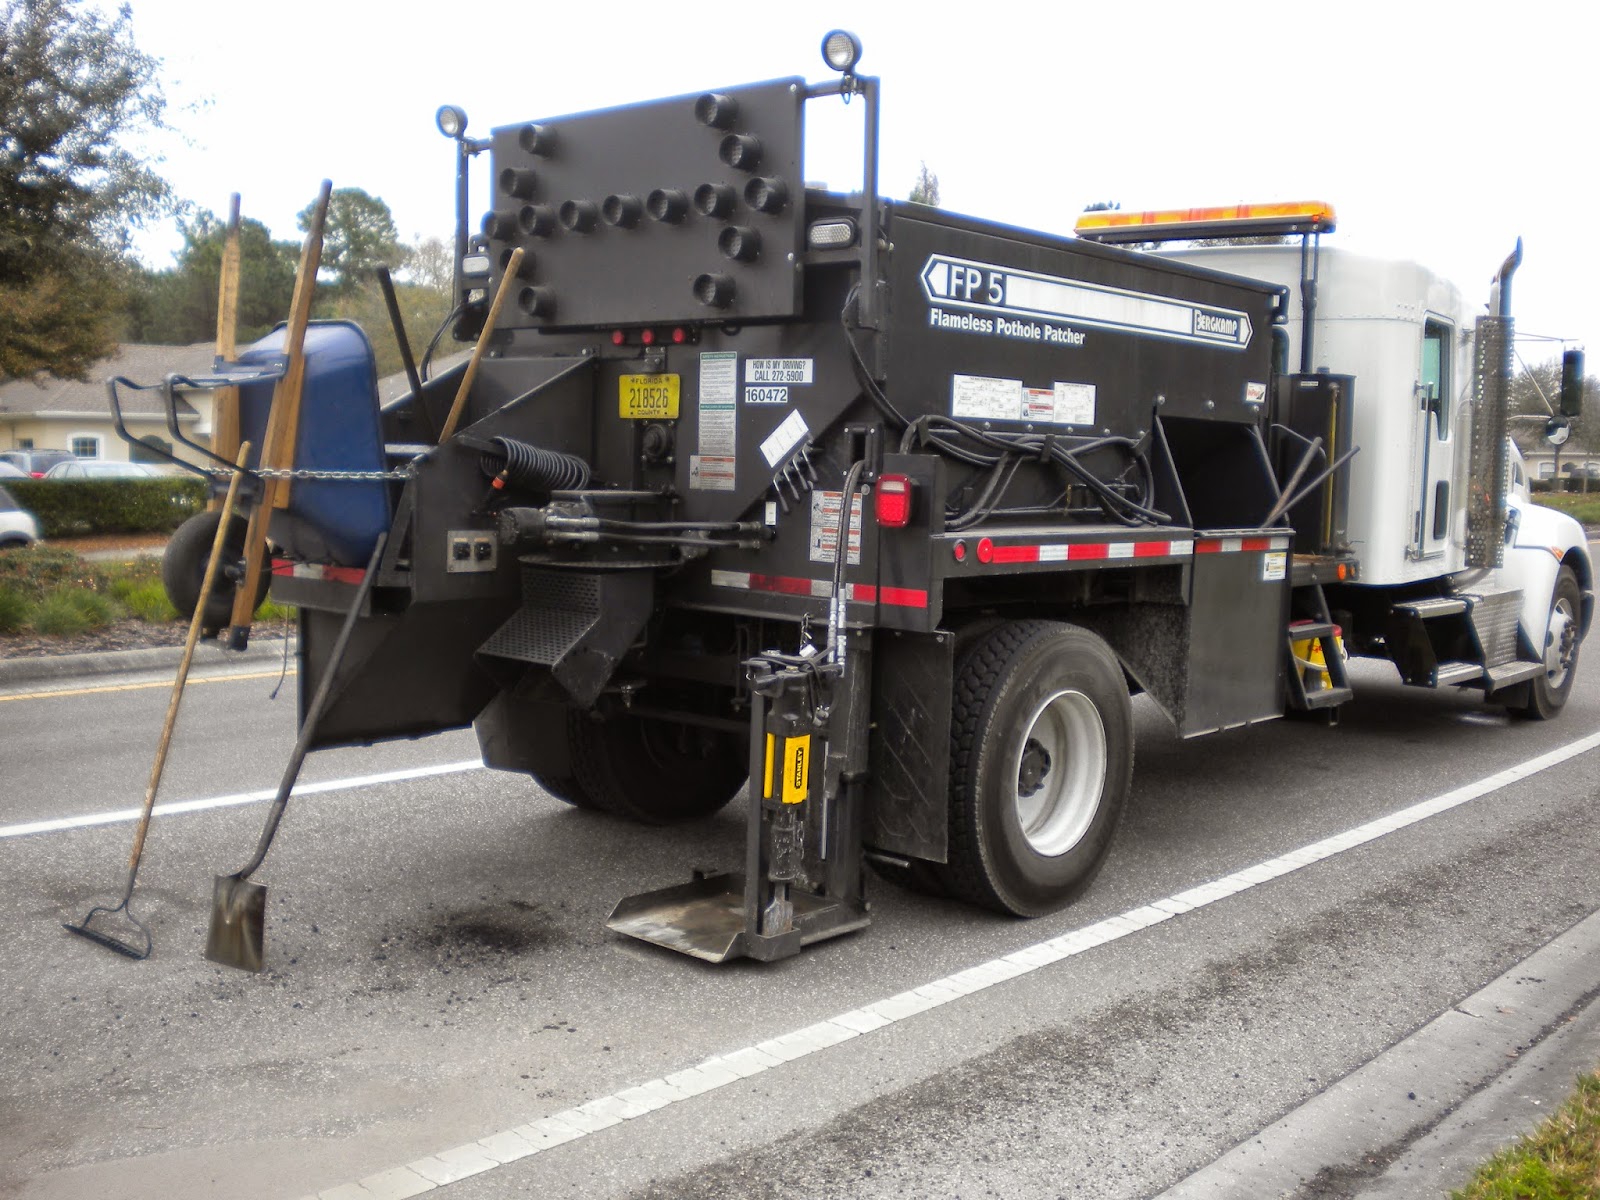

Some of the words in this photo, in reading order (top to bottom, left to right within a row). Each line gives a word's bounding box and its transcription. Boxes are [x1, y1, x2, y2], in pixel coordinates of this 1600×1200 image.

[950, 265, 982, 299] FP
[988, 272, 1003, 303] 5
[930, 308, 993, 333] Flameless
[997, 317, 1041, 339] Pothole
[1044, 324, 1086, 345] Patcher
[1194, 309, 1238, 336] BERGKAMP
[752, 360, 765, 370] HOW
[766, 360, 772, 369] IS
[773, 361, 781, 369] MY
[782, 361, 806, 370] DRIVING?
[635, 377, 663, 385] FLORIDA
[754, 370, 769, 381] CALL
[772, 370, 804, 381] 272-5900
[630, 388, 669, 408] 218526
[746, 388, 787, 401] 160472
[795, 749, 803, 787] STANLEY
